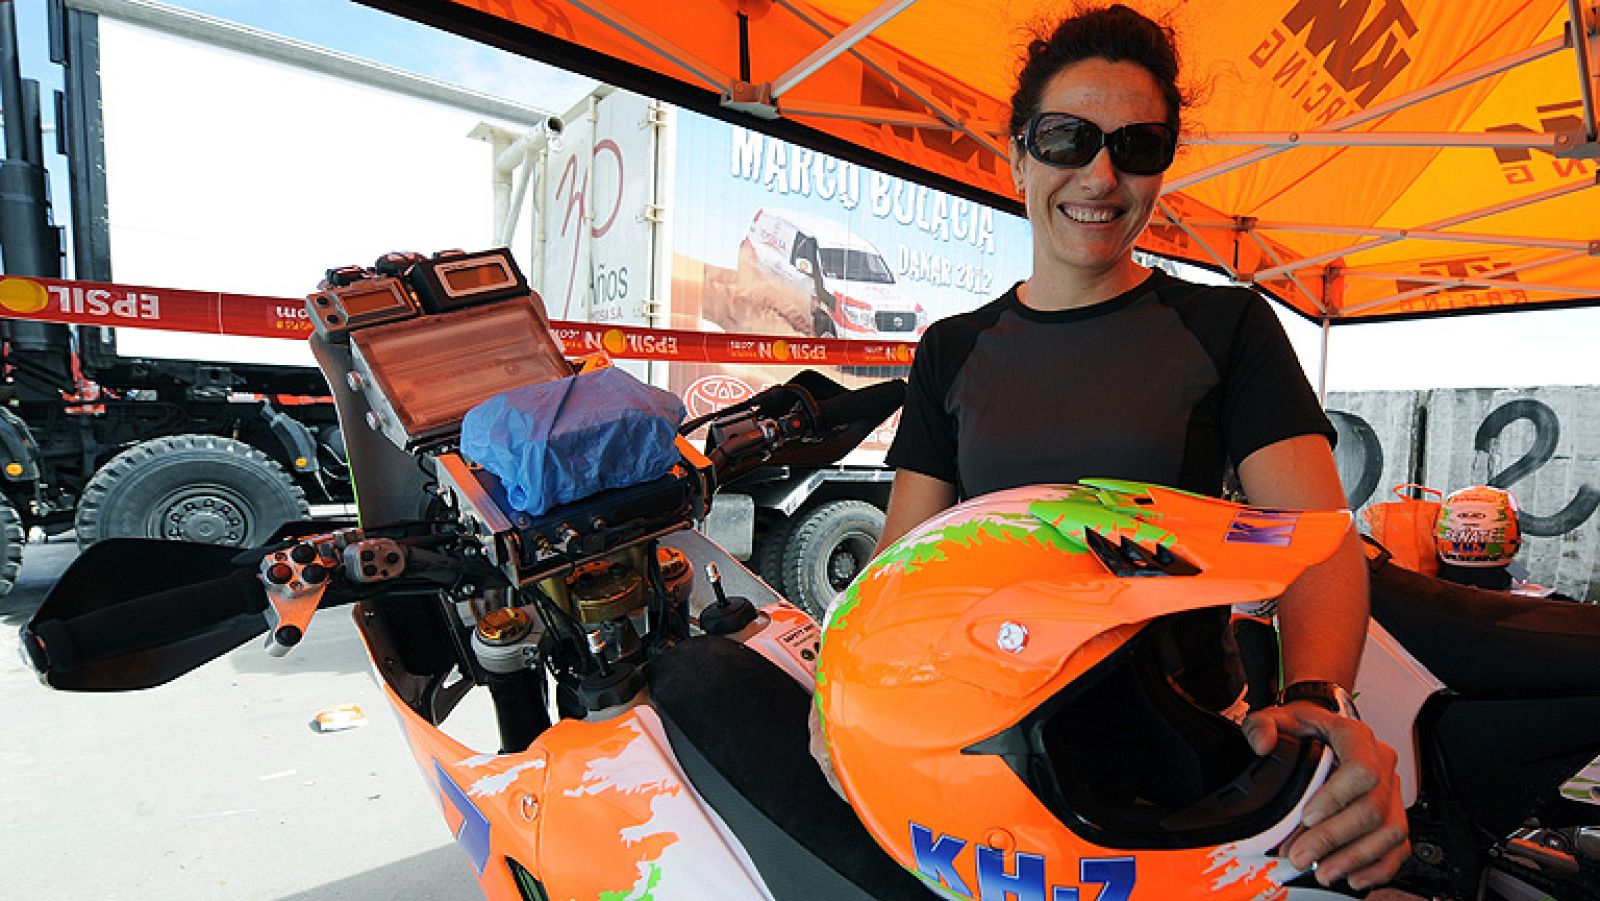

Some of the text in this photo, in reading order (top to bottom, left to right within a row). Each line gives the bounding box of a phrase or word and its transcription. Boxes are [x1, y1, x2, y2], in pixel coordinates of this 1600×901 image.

[730, 124, 860, 210] MARCO
[869, 170, 996, 254] BOLACIA
[898, 243, 994, 295] DAKAR 2012
